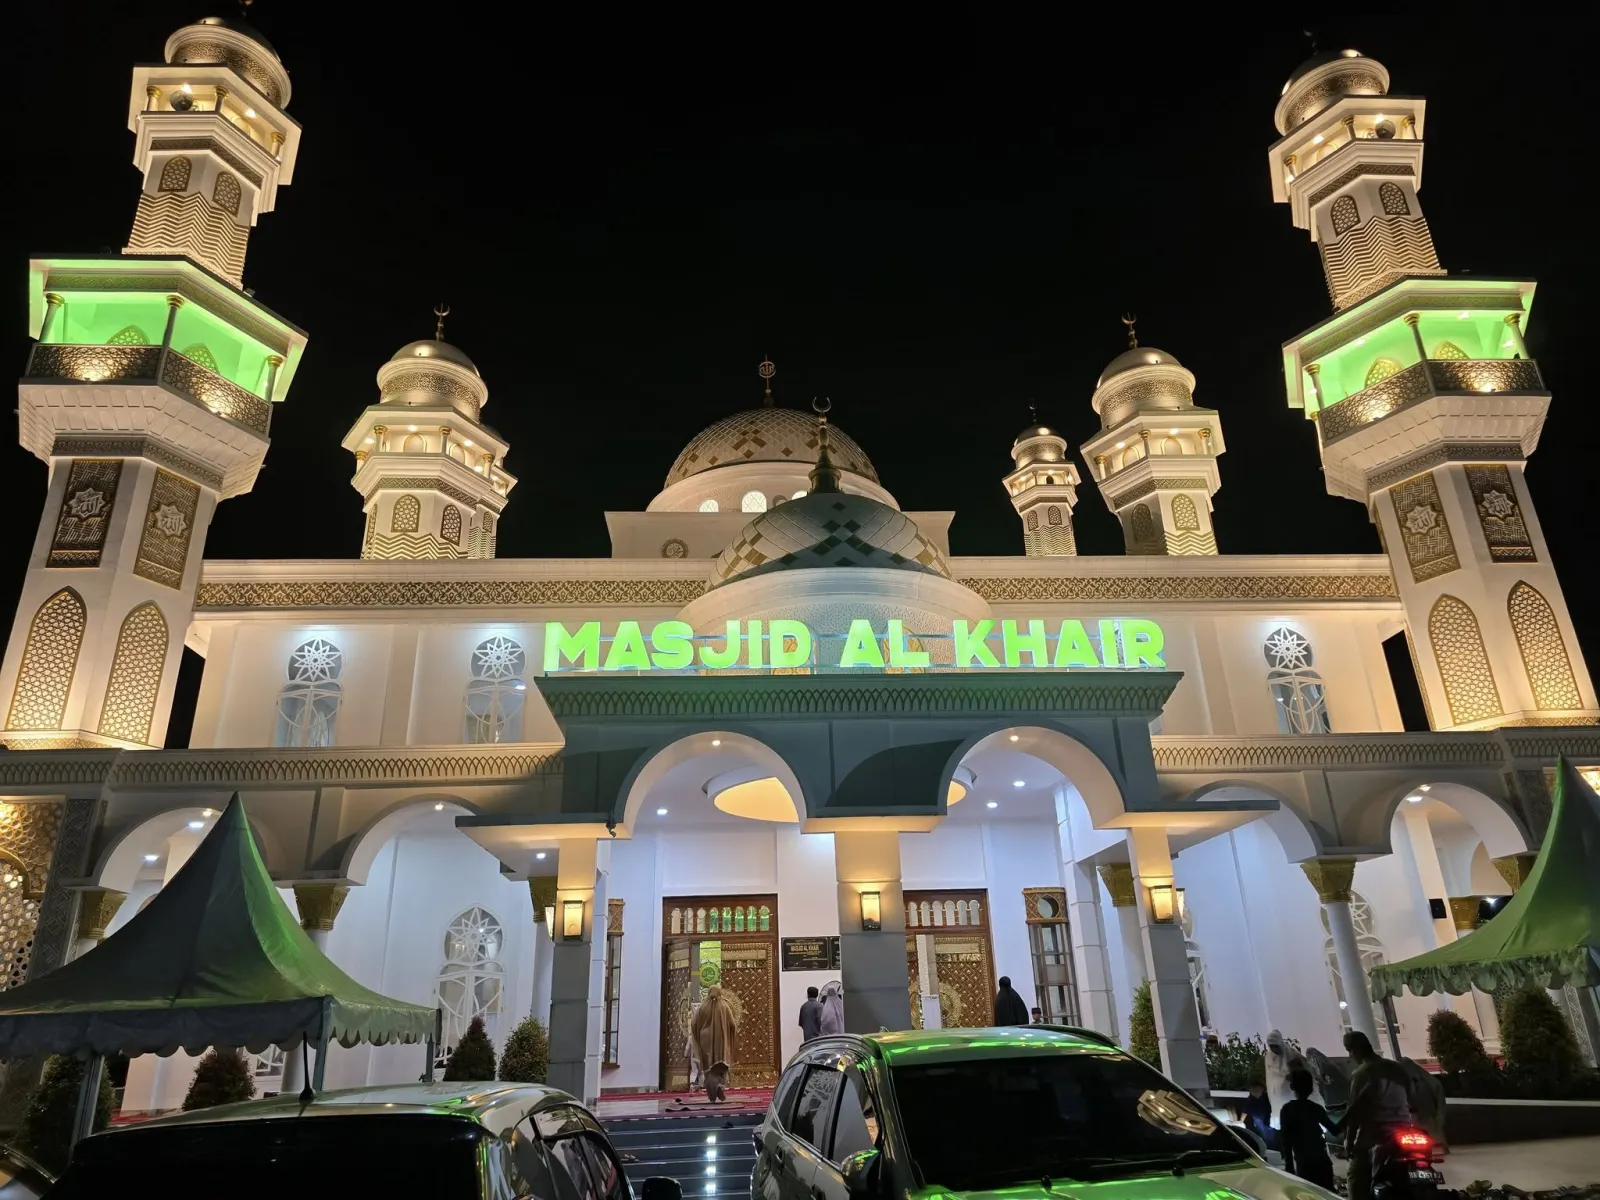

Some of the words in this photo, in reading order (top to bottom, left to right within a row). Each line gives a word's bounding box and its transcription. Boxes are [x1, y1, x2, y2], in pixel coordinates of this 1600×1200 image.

[543, 619, 812, 670] MASJID
[839, 619, 931, 668] AL
[953, 619, 1167, 668] KHAIR
